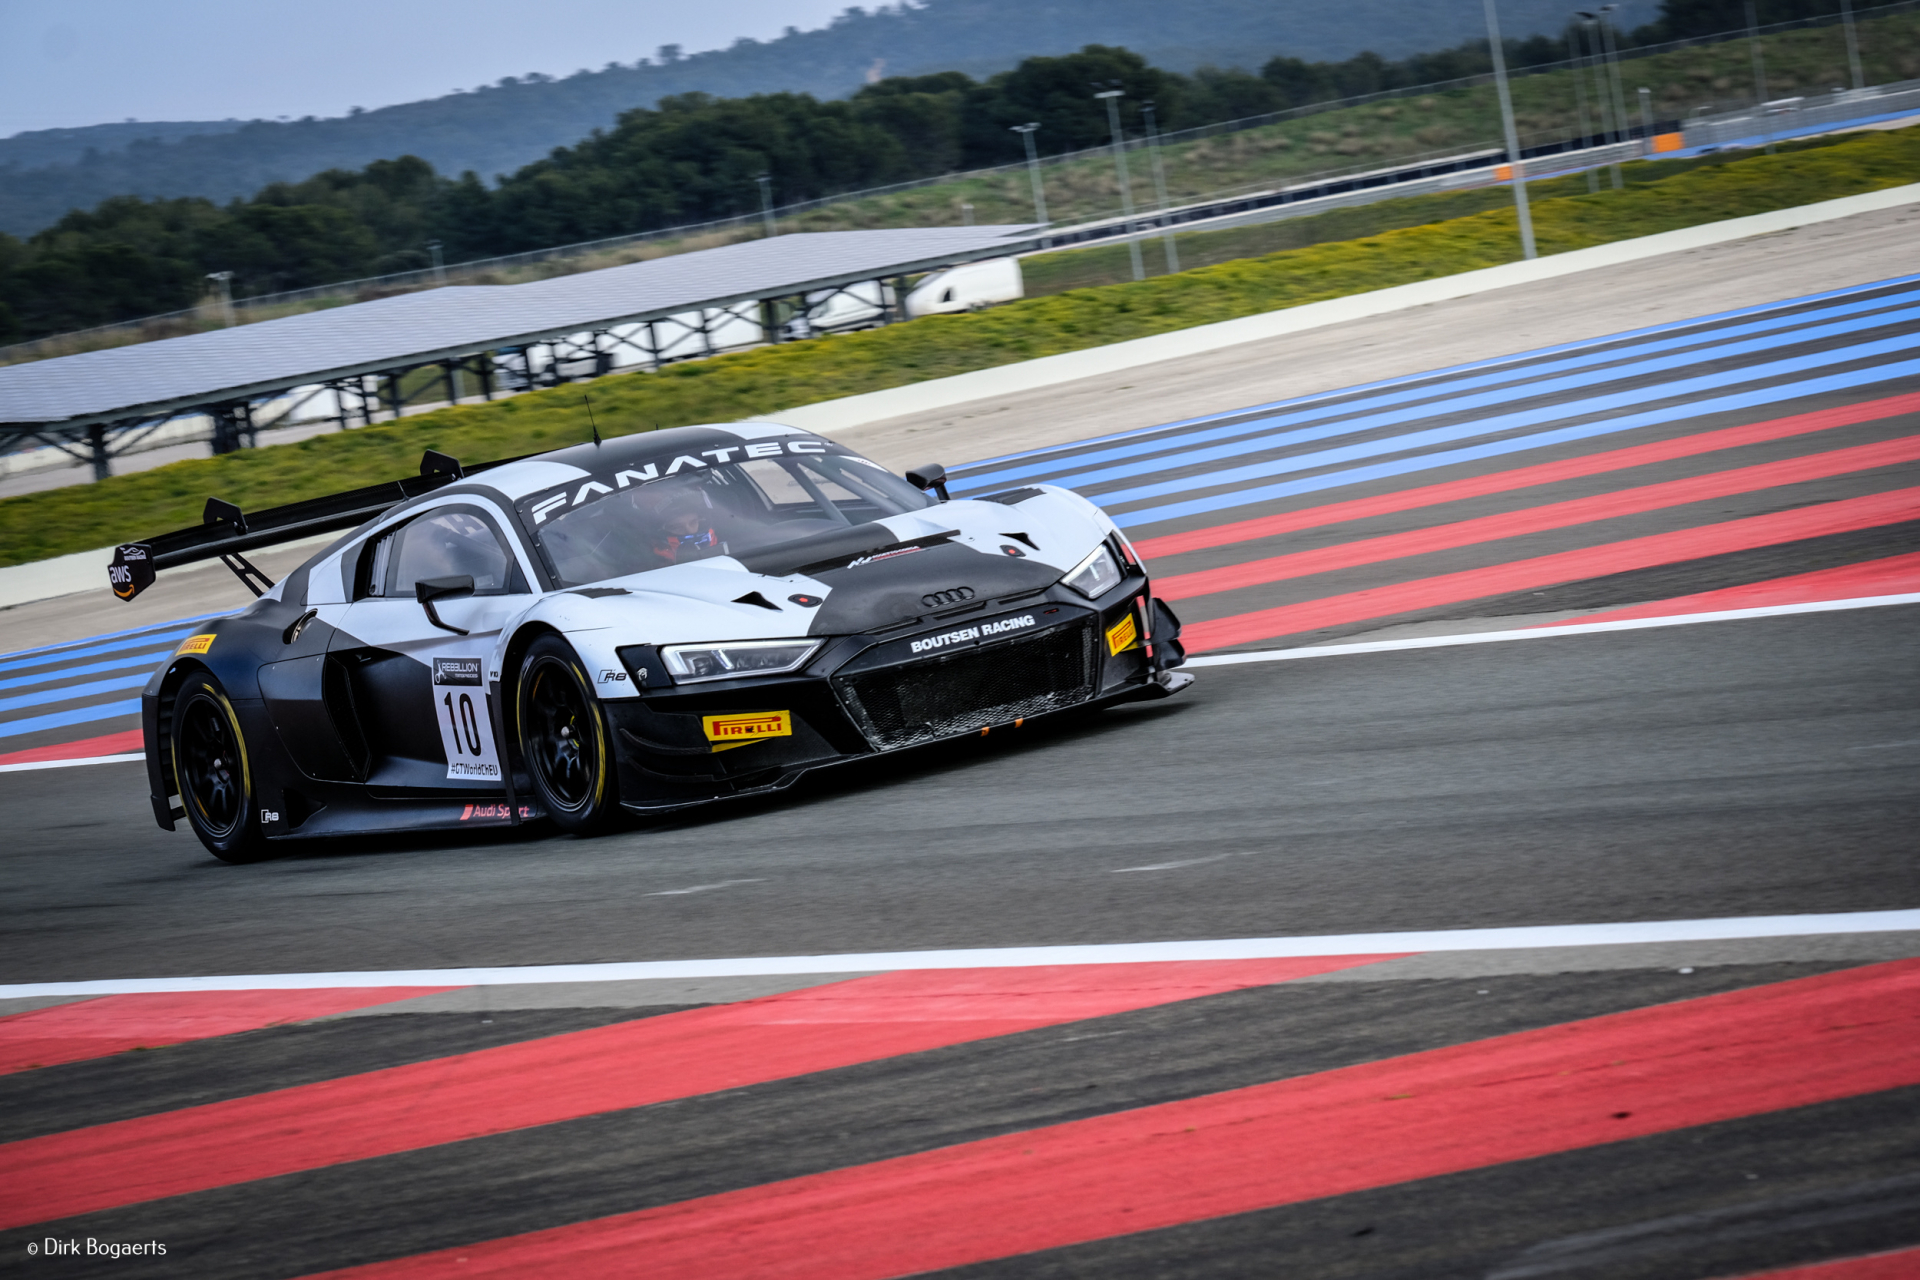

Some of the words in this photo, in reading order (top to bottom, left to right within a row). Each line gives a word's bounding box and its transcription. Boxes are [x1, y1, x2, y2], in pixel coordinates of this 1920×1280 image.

[532, 441, 826, 525] FANATEC
[109, 565, 131, 584] aws
[910, 623, 980, 653] BOUTSEN
[981, 614, 1036, 637] RACING
[1111, 620, 1134, 649] PIRELLI
[441, 662, 478, 673] REBELLION
[602, 671, 627, 682] R8
[444, 691, 482, 757] 10
[712, 715, 782, 736] PIRELLI
[450, 762, 499, 776] #GTWorldChEU
[263, 811, 279, 822] R8
[473, 805, 496, 818] Audi
[498, 804, 530, 818] Sprt
